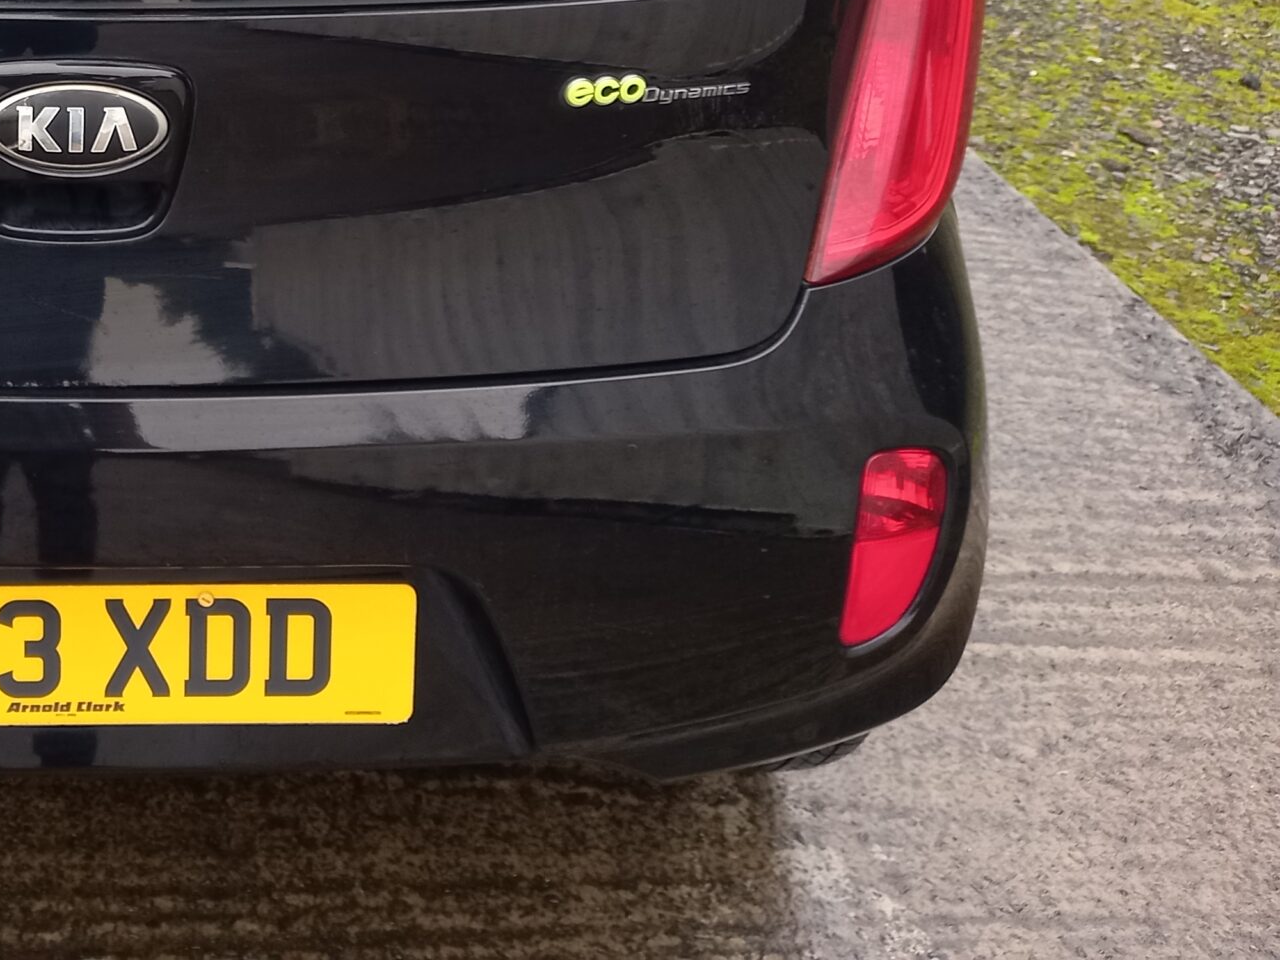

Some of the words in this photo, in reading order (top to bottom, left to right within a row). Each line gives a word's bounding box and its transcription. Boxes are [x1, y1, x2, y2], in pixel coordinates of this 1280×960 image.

[16, 105, 138, 153] KIA
[104, 597, 333, 698] XDD
[6, 701, 72, 713] Arnold
[76, 701, 126, 713] Clark
